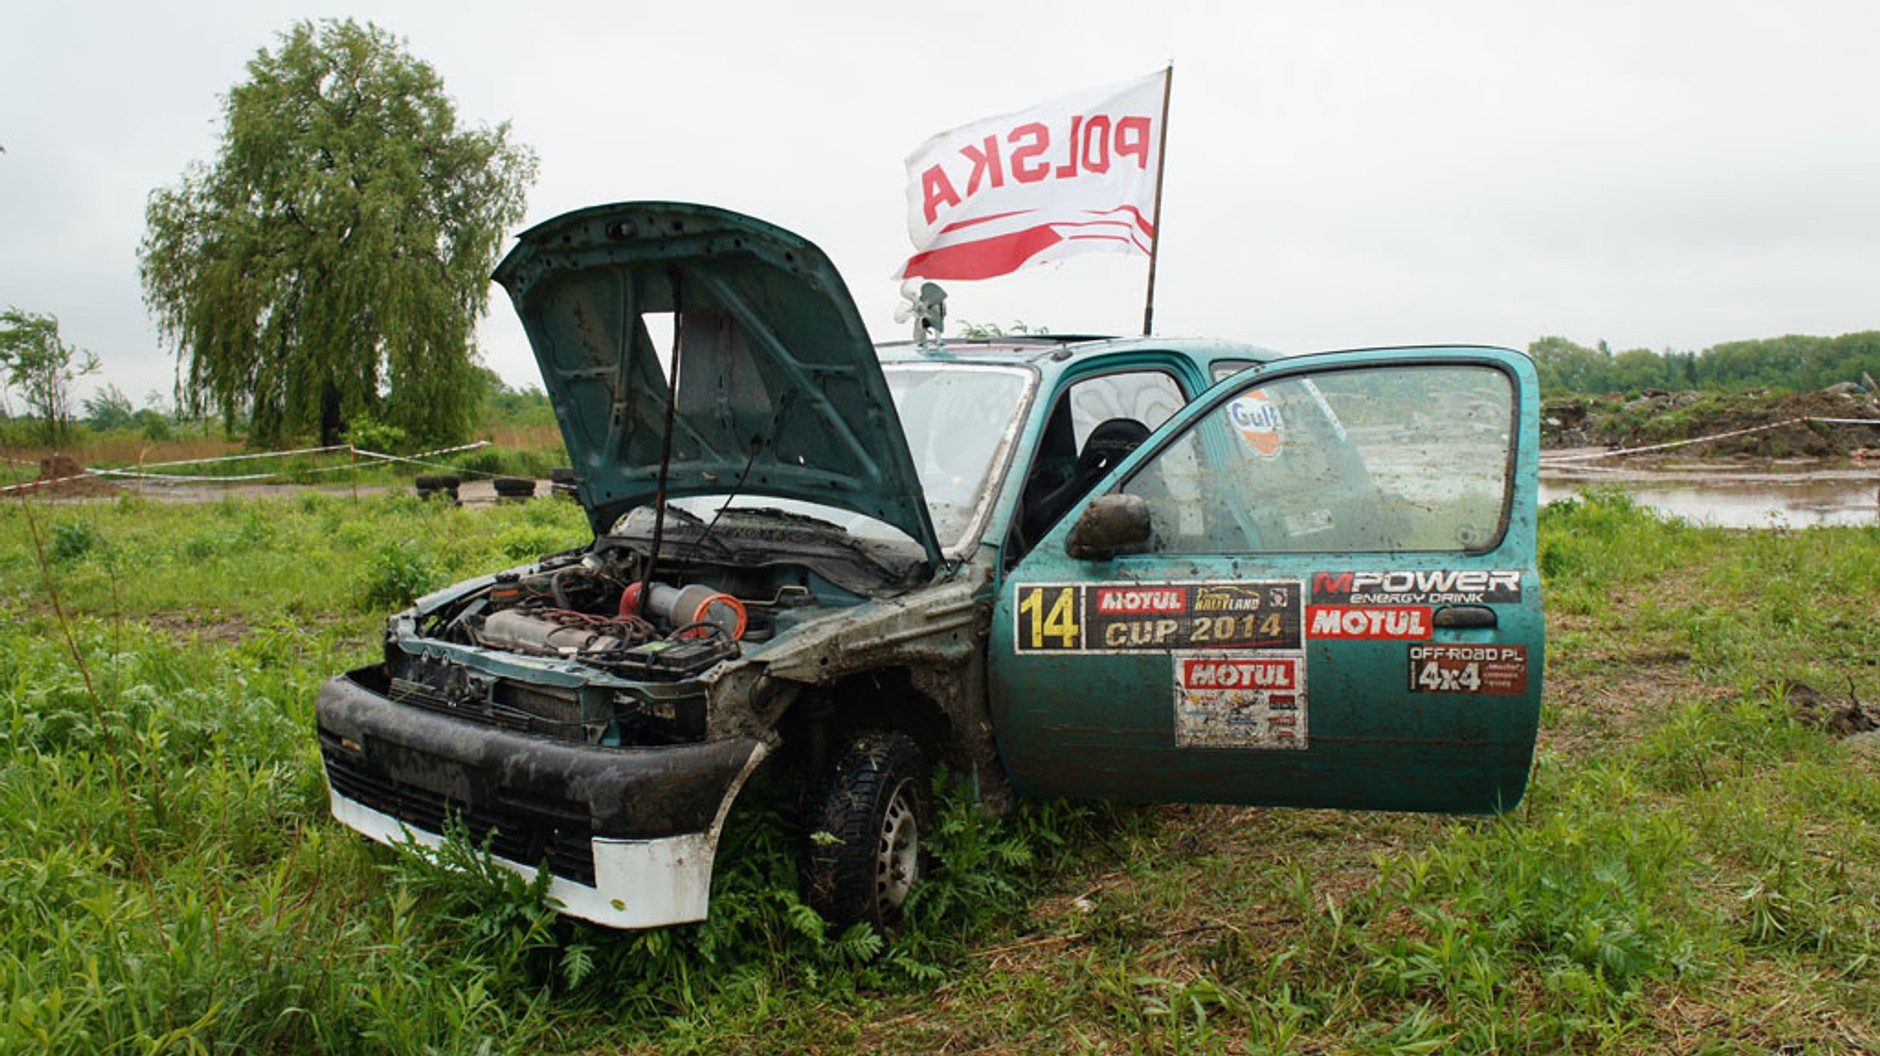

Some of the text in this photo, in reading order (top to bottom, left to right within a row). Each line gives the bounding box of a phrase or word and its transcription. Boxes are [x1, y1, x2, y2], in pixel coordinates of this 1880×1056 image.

[1231, 401, 1279, 427] Gulf
[1101, 590, 1182, 610] MOTUL
[1428, 593, 1484, 603] DRINK
[1020, 587, 1079, 648] 14
[1105, 612, 1283, 647] CUP 2014
[1311, 609, 1425, 636] MOTUL
[1190, 664, 1290, 687] MOTUL
[1419, 661, 1481, 691] 4x4
